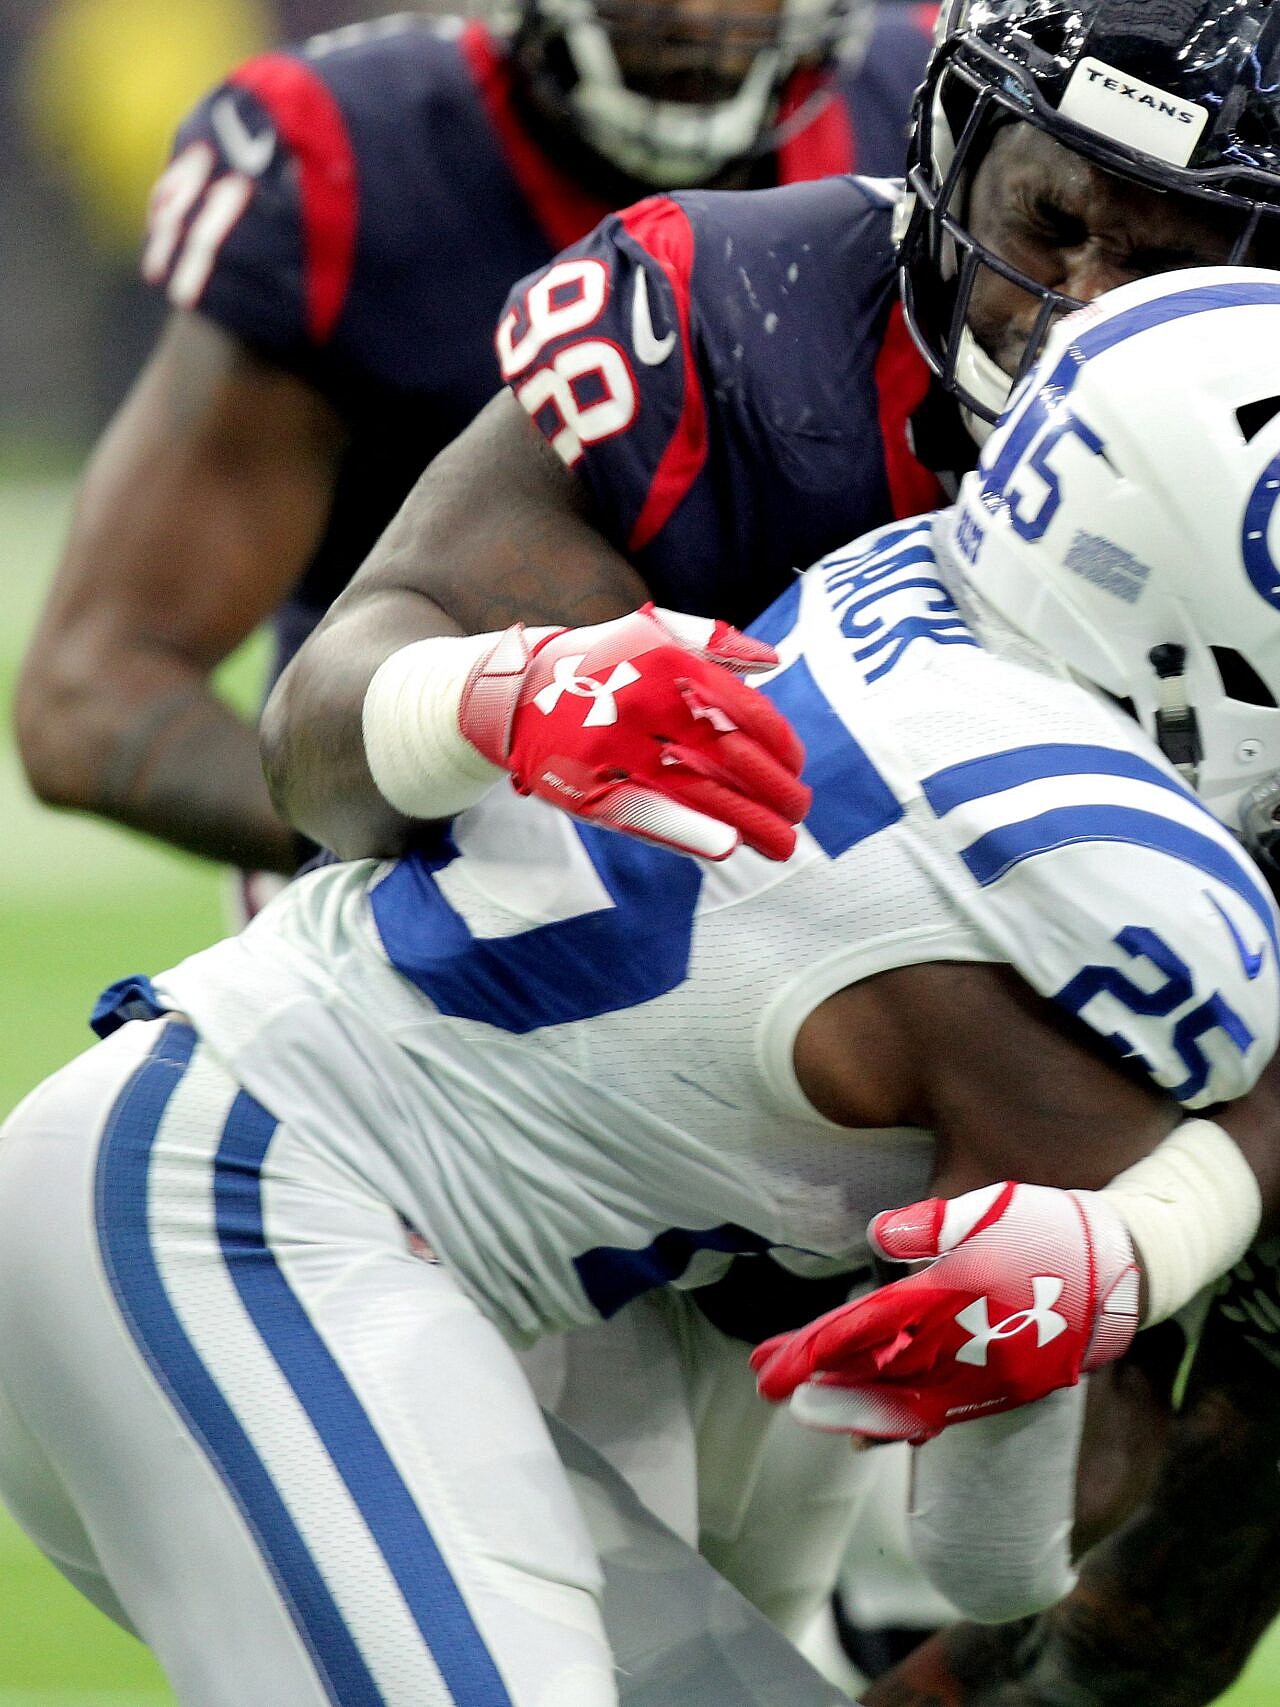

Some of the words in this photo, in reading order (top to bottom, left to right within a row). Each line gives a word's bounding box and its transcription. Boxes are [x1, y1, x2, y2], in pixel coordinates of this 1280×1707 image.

[1085, 67, 1195, 125] TEXANS
[495, 256, 641, 470] 98
[1048, 925, 1256, 1103] 25
